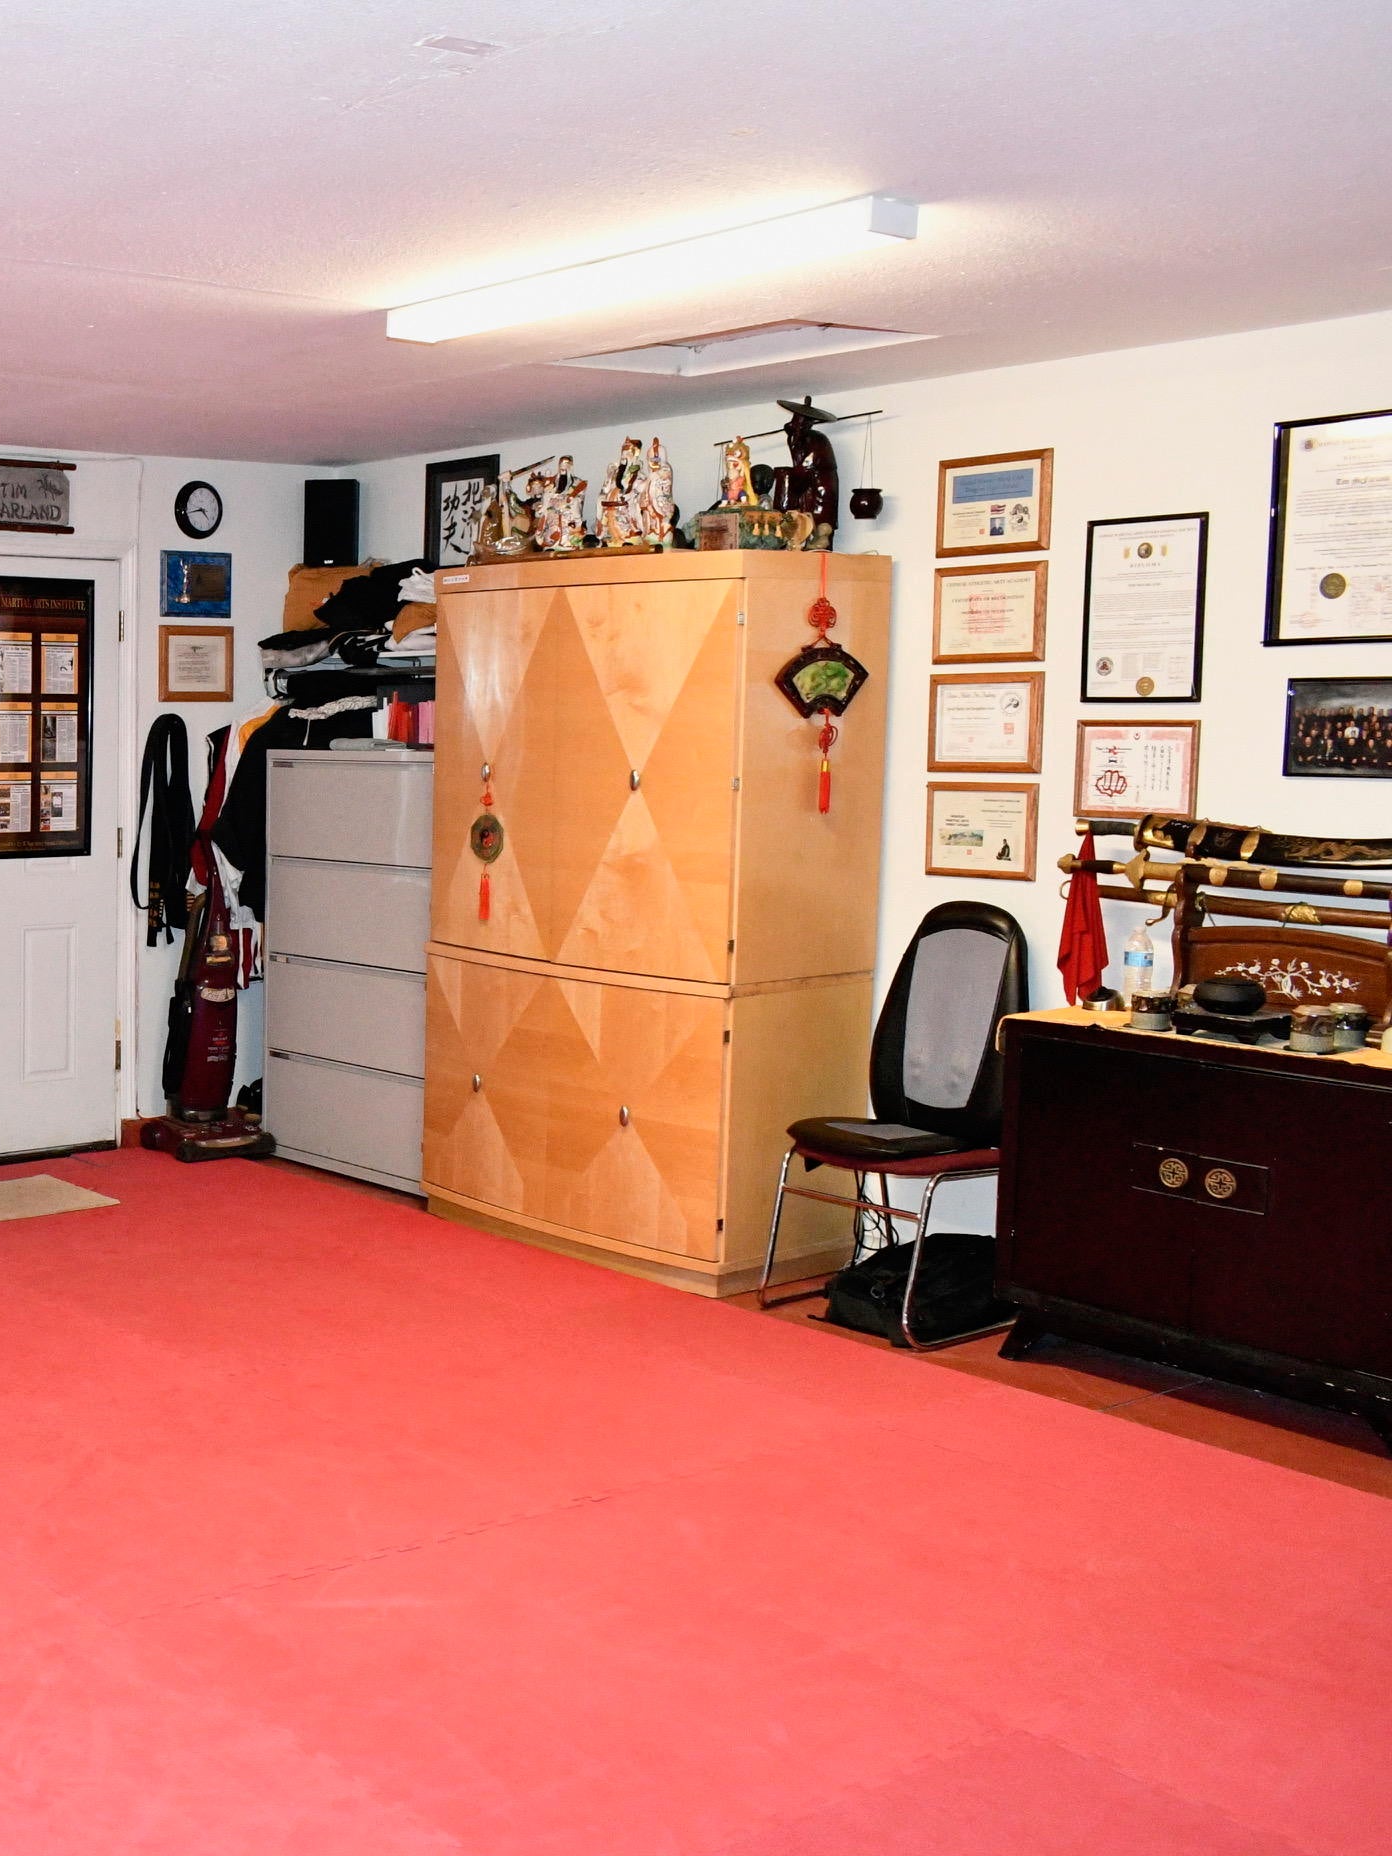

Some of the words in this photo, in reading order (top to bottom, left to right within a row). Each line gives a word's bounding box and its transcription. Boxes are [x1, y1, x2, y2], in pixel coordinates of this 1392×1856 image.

[0, 482, 27, 499] TIM
[1, 597, 32, 609] MARTIAL
[33, 598, 50, 610] ARTS
[50, 599, 86, 611] INSTITUTE
